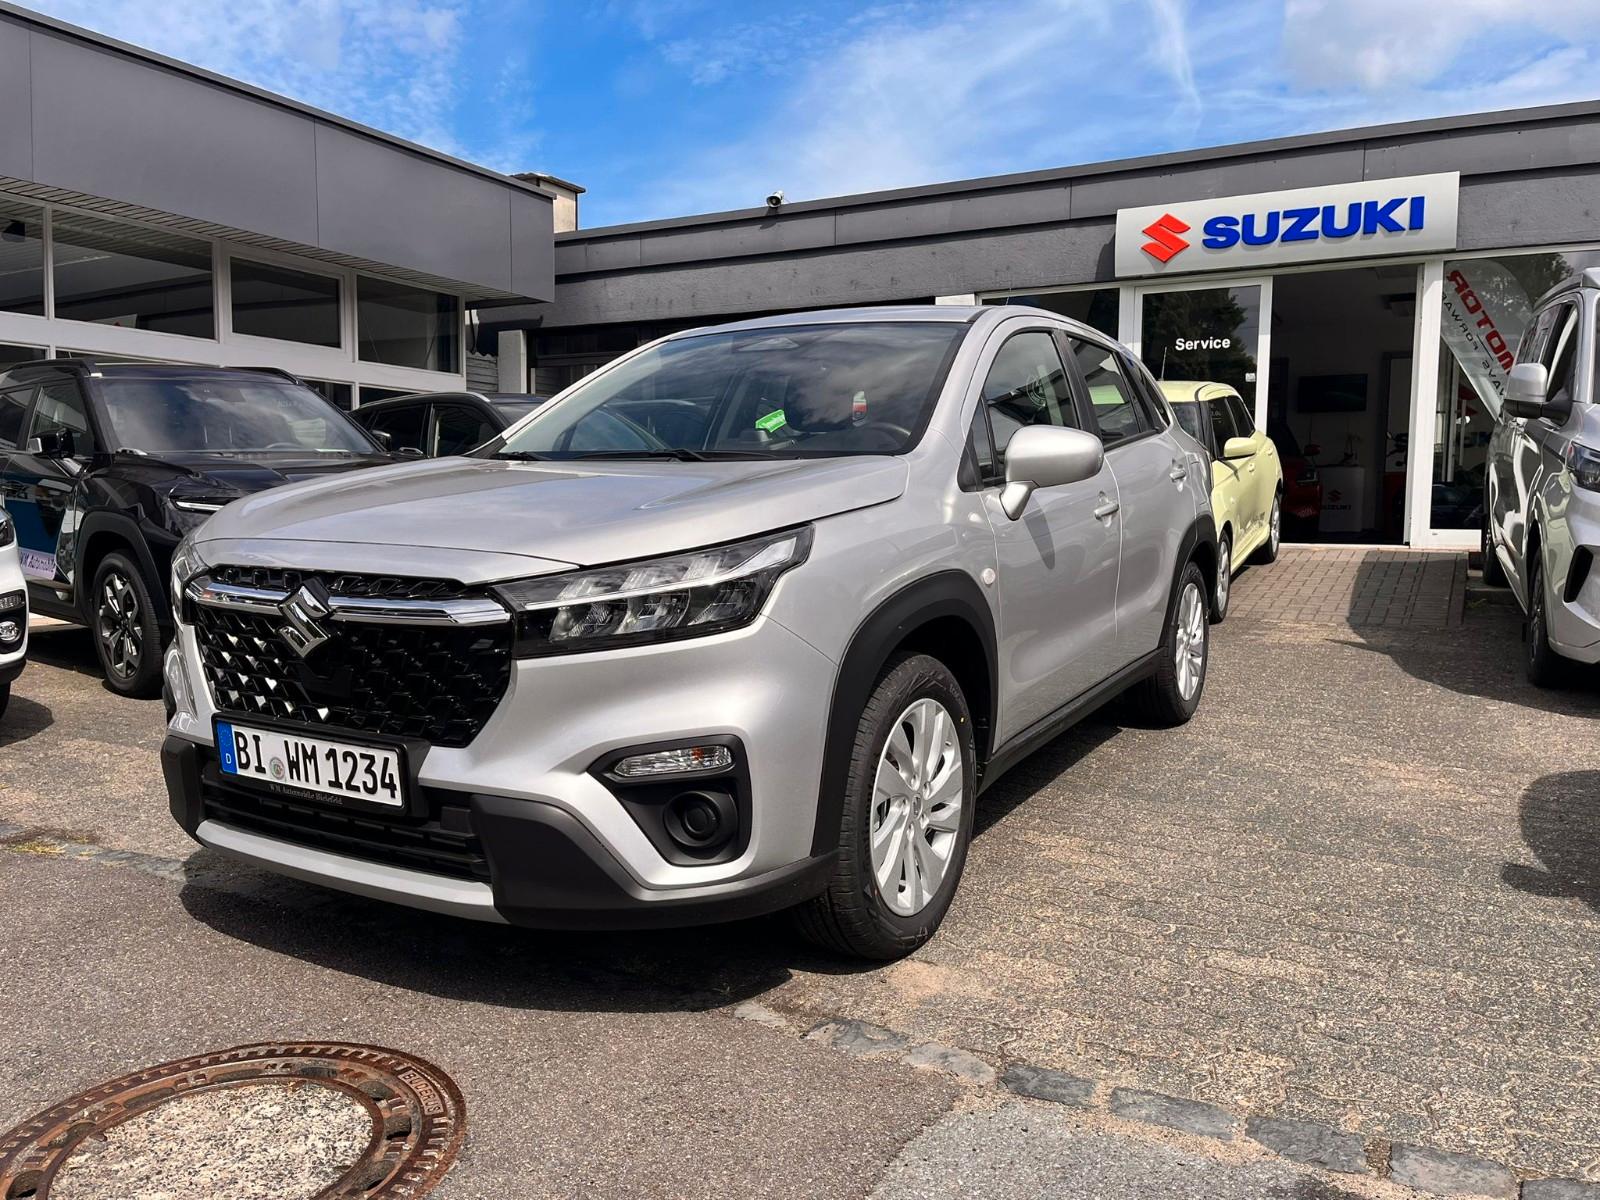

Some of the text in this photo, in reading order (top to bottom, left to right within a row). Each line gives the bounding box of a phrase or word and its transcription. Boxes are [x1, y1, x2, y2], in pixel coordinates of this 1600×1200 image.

[1202, 196, 1425, 250] SUZUKI
[1175, 336, 1231, 351] Service
[226, 753, 232, 764] D
[234, 731, 397, 799] BI WM 1234
[402, 1073, 441, 1113] BUDERUS
